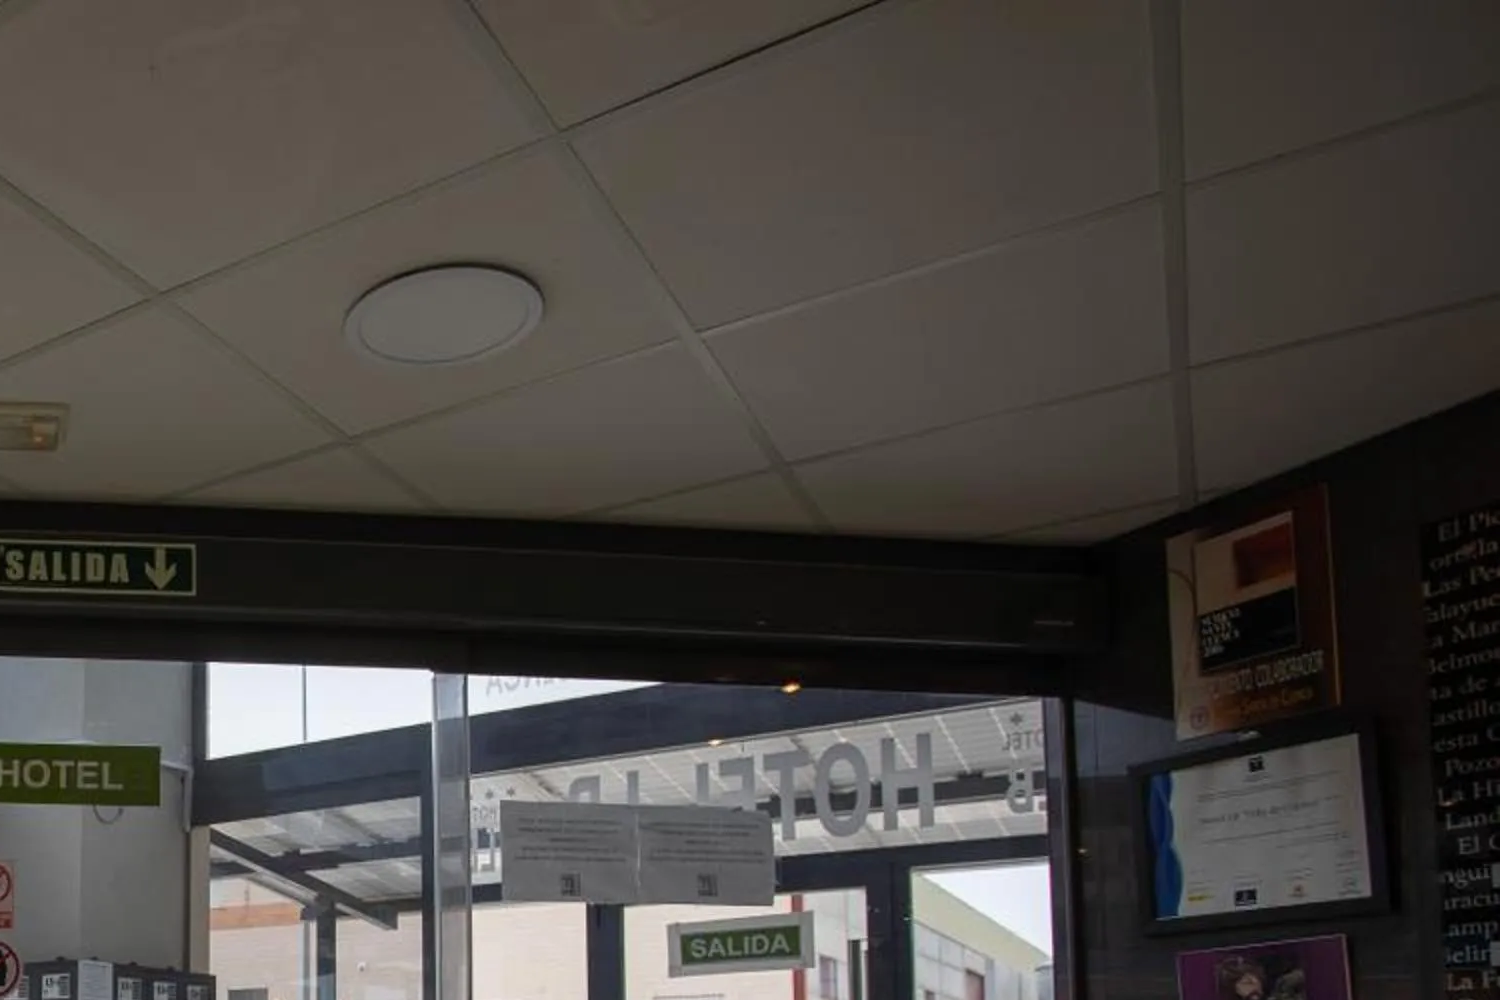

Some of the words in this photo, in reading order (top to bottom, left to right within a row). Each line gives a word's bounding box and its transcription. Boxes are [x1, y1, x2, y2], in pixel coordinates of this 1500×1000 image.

[5, 548, 130, 583] SALIDA
[1432, 698, 1500, 728] astillo
[1458, 833, 1479, 855] El
[690, 933, 790, 959] SALIDA
[1446, 972, 1474, 992] La
